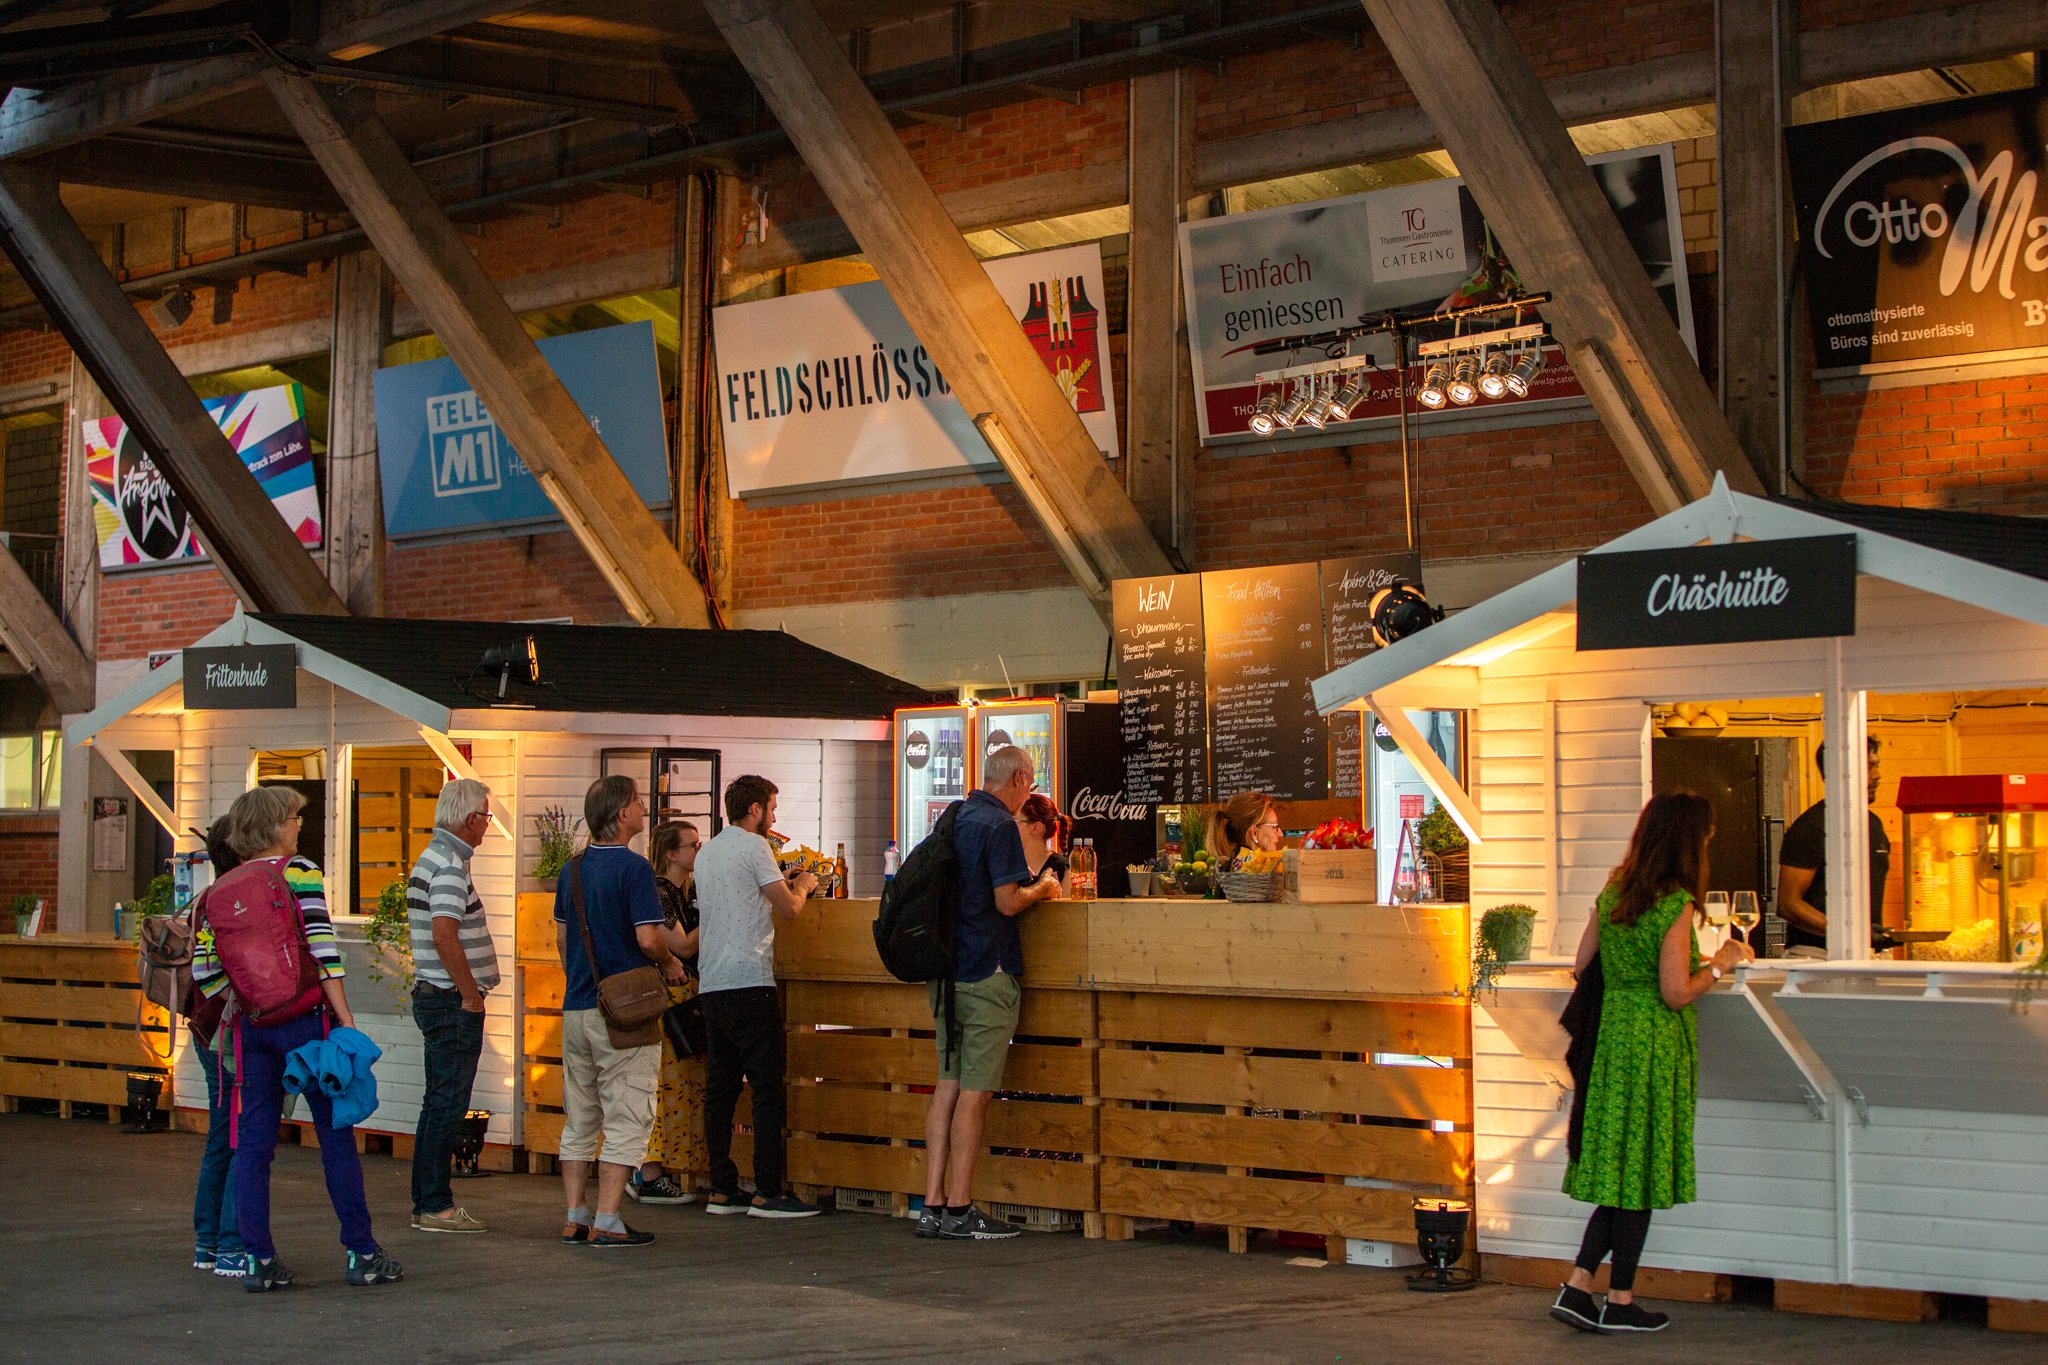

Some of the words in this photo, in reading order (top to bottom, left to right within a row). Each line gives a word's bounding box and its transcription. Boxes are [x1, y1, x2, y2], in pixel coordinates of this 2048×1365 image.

[1402, 208, 1425, 232] TG
[1844, 199, 1948, 247] Otto
[1380, 234, 1411, 246] Thommen
[1411, 227, 1453, 241] Gastronomie
[1382, 247, 1455, 269] CATERING
[1219, 253, 1312, 294] Einfach
[1224, 297, 1344, 341] geniessen
[1827, 304, 1925, 327] ottomathysierte
[1830, 333, 1868, 350] Büros
[1871, 331, 1899, 346] sind
[1901, 321, 1975, 342] zuverlässig
[432, 396, 488, 428] TELE
[440, 431, 494, 487] M1
[1138, 578, 1176, 613] WEIN
[1338, 568, 1368, 599] Apéro
[1366, 569, 1377, 591] &
[1375, 569, 1400, 588] Bier
[1646, 566, 1790, 617] Chäshütte
[1131, 615, 1186, 639] Schaumwein
[205, 662, 268, 691] Frittenbude
[1143, 664, 1176, 681] Weisswein
[1147, 740, 1175, 752] Rotwein
